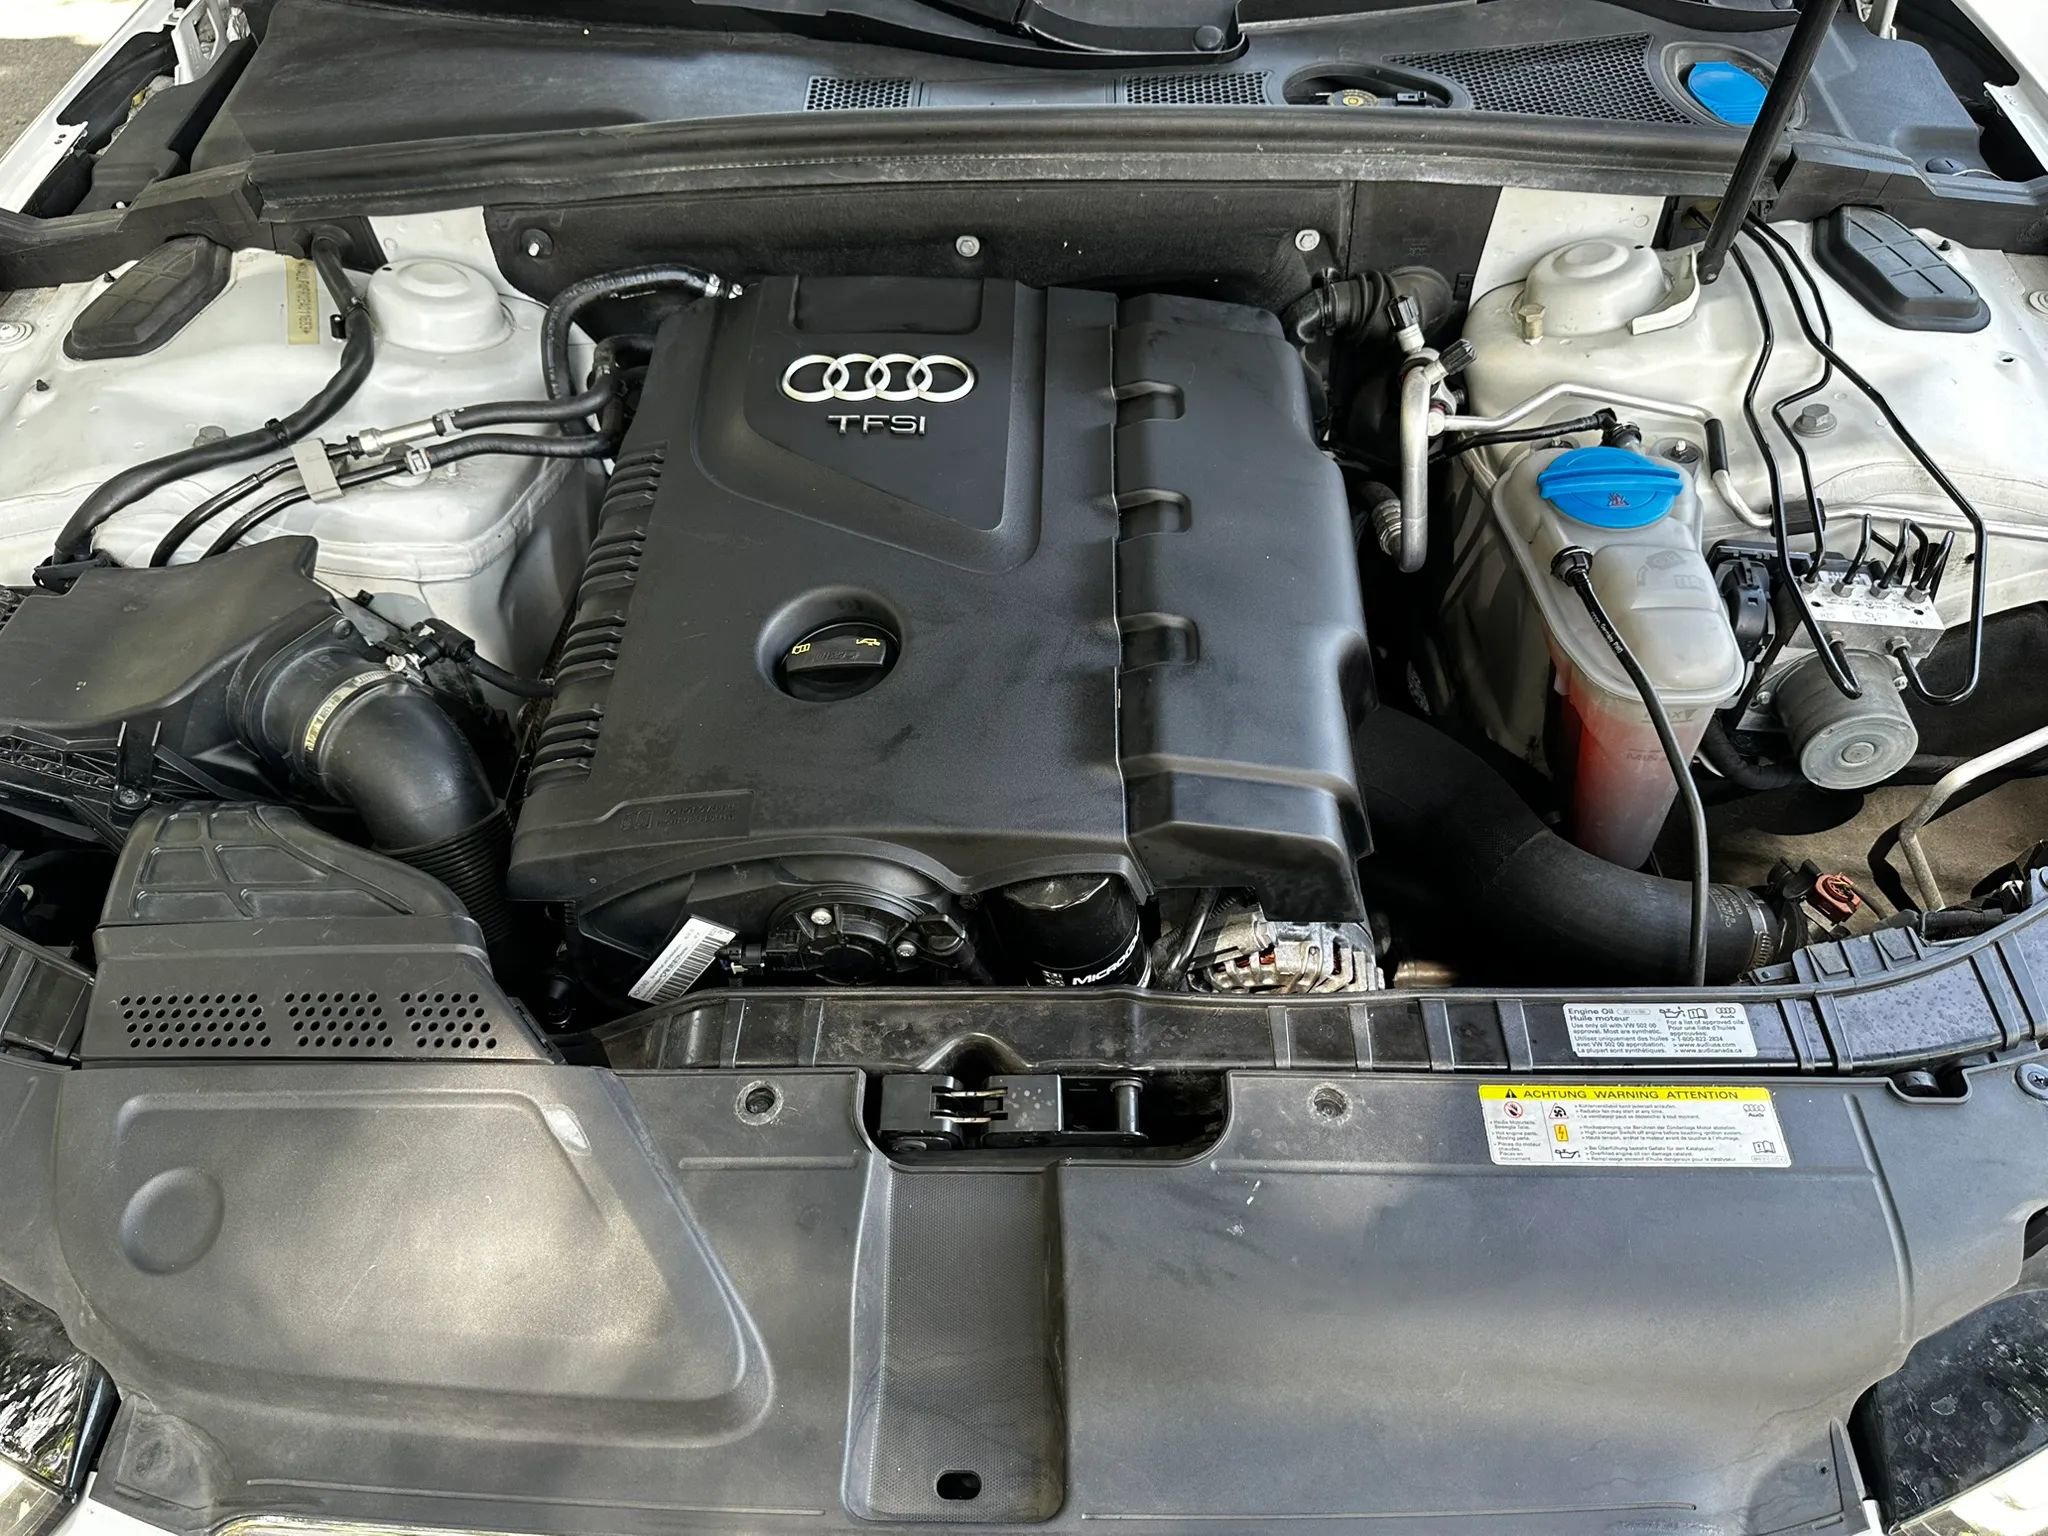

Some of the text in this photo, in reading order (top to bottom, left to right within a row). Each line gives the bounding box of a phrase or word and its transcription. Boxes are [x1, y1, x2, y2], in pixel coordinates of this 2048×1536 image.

[827, 414, 926, 434] TFSI
[1523, 1090, 1739, 1099] ACHTUNG WARNING ATTENTION
